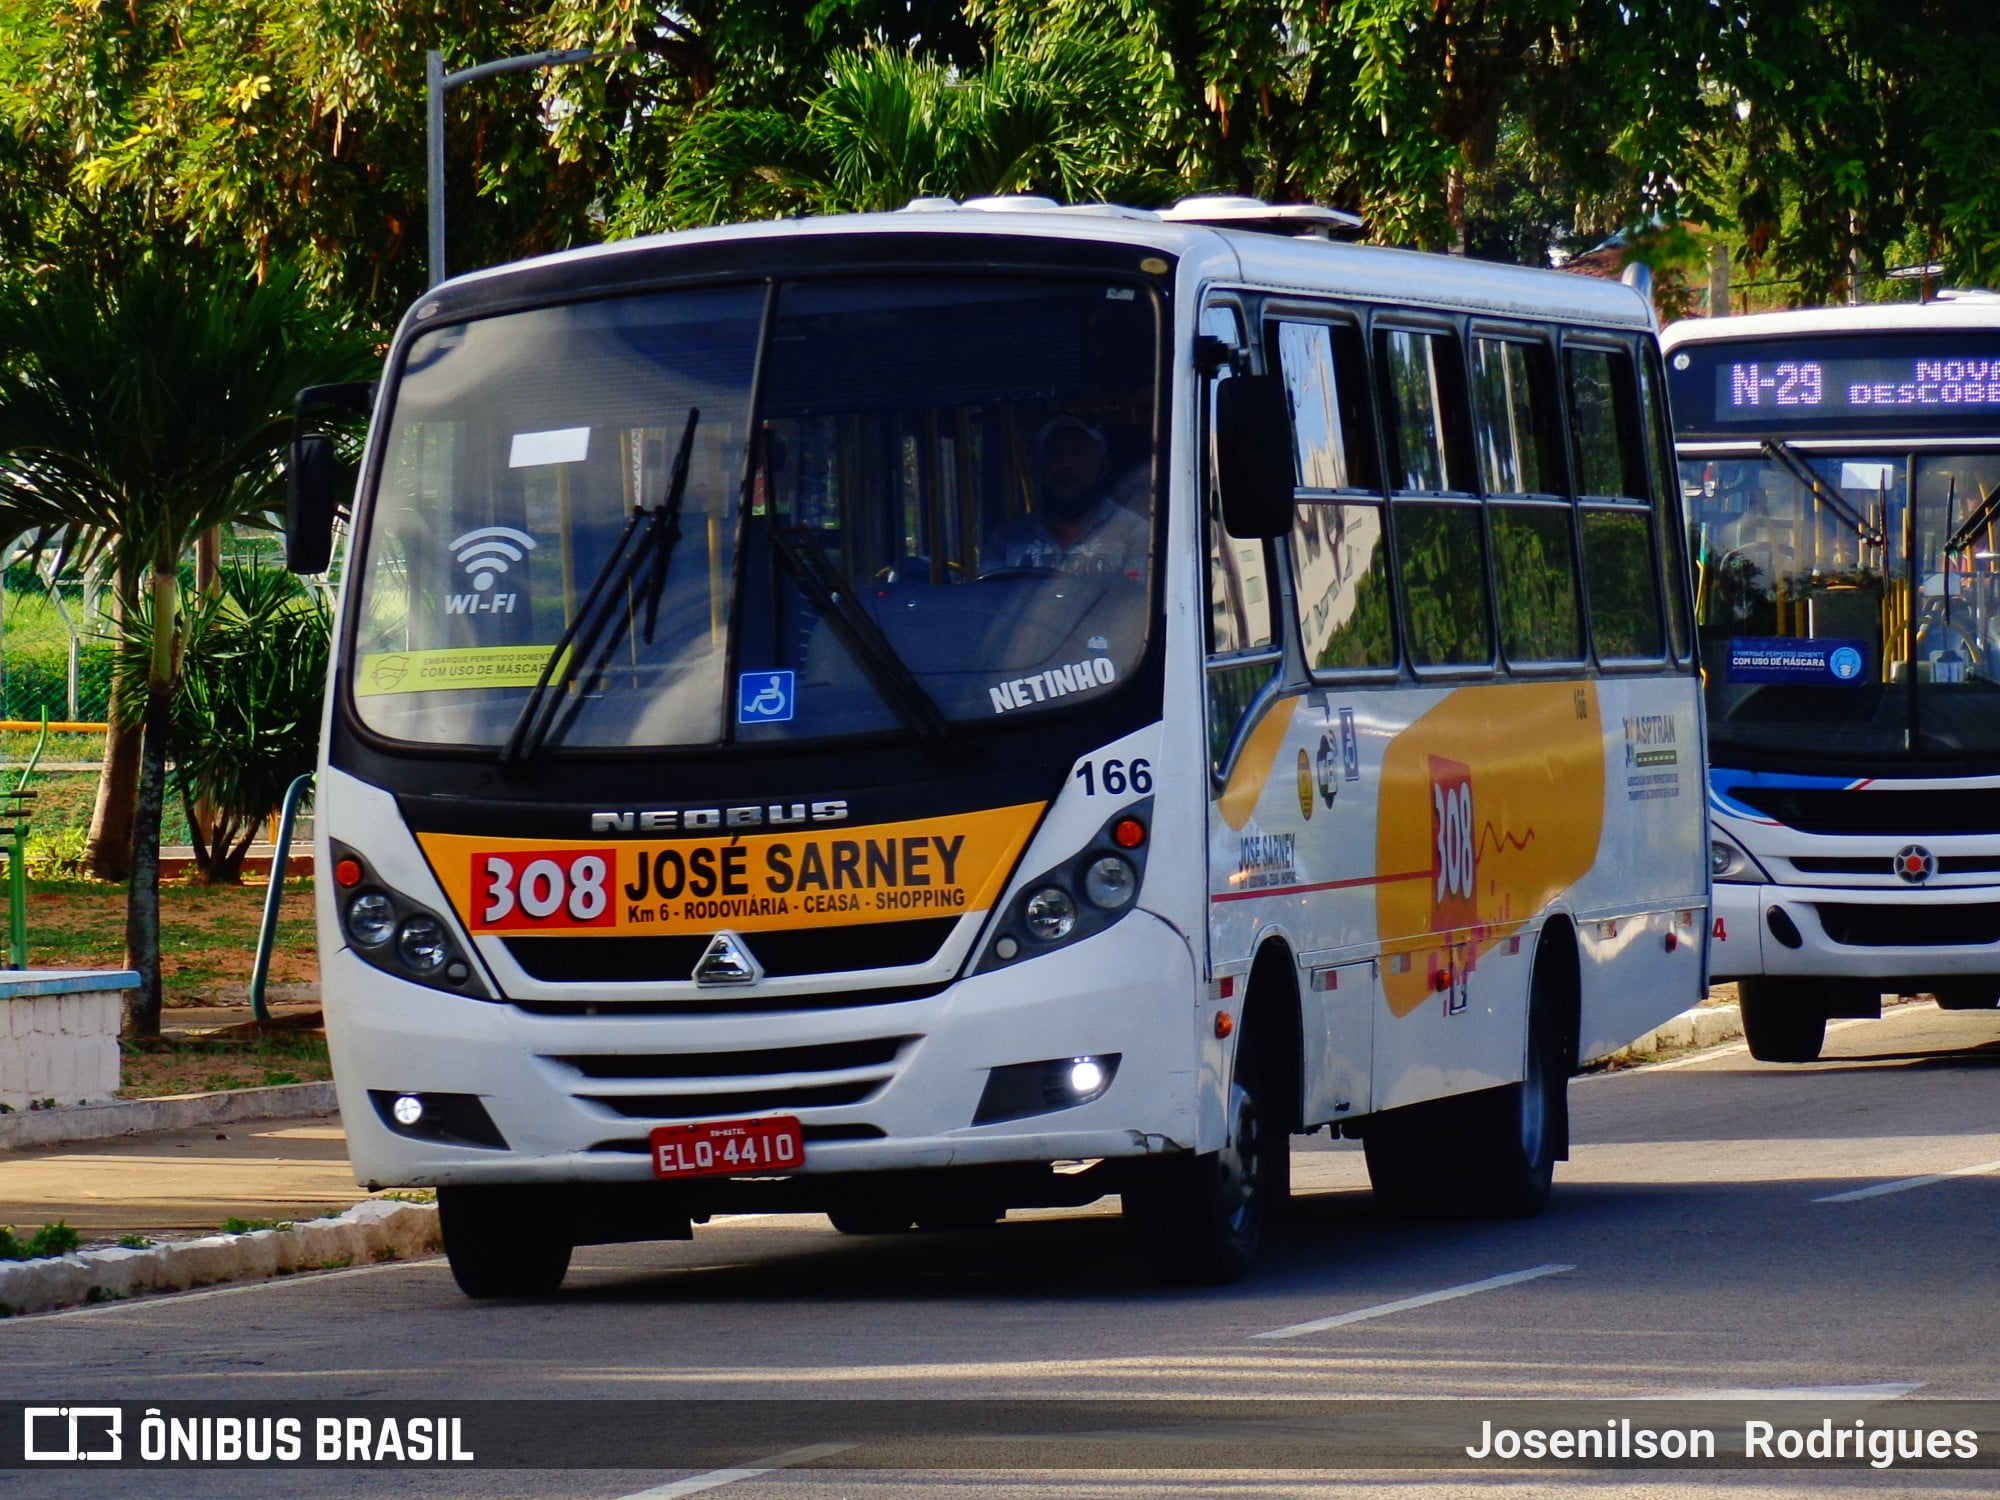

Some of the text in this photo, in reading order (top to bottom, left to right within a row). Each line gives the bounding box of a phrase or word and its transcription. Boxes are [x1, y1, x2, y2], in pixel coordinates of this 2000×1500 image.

[1732, 363, 1821, 405] N-29
[445, 593, 516, 614] WI-FI
[420, 661, 548, 678] COM USO DE MÁSCAR
[469, 654, 513, 664] PERMITIDO
[516, 653, 551, 662] SOMENT
[1732, 656, 1826, 667] COM USO DE MÁSCARA
[988, 657, 1116, 714] NETINHO
[1636, 715, 1676, 744] ASPTRAN
[1076, 758, 1152, 796] 166
[592, 801, 848, 831] NEOBUS
[1263, 833, 1295, 869] SARNEY
[1434, 781, 1474, 904] 308
[624, 835, 966, 902] JOSÉ SARNEY
[484, 856, 607, 923] 308
[628, 905, 654, 923] Km
[659, 903, 669, 921] 6
[684, 895, 788, 920] RODOVIÁRIA
[804, 894, 860, 913] CEASA
[876, 888, 965, 910] SHOPPING
